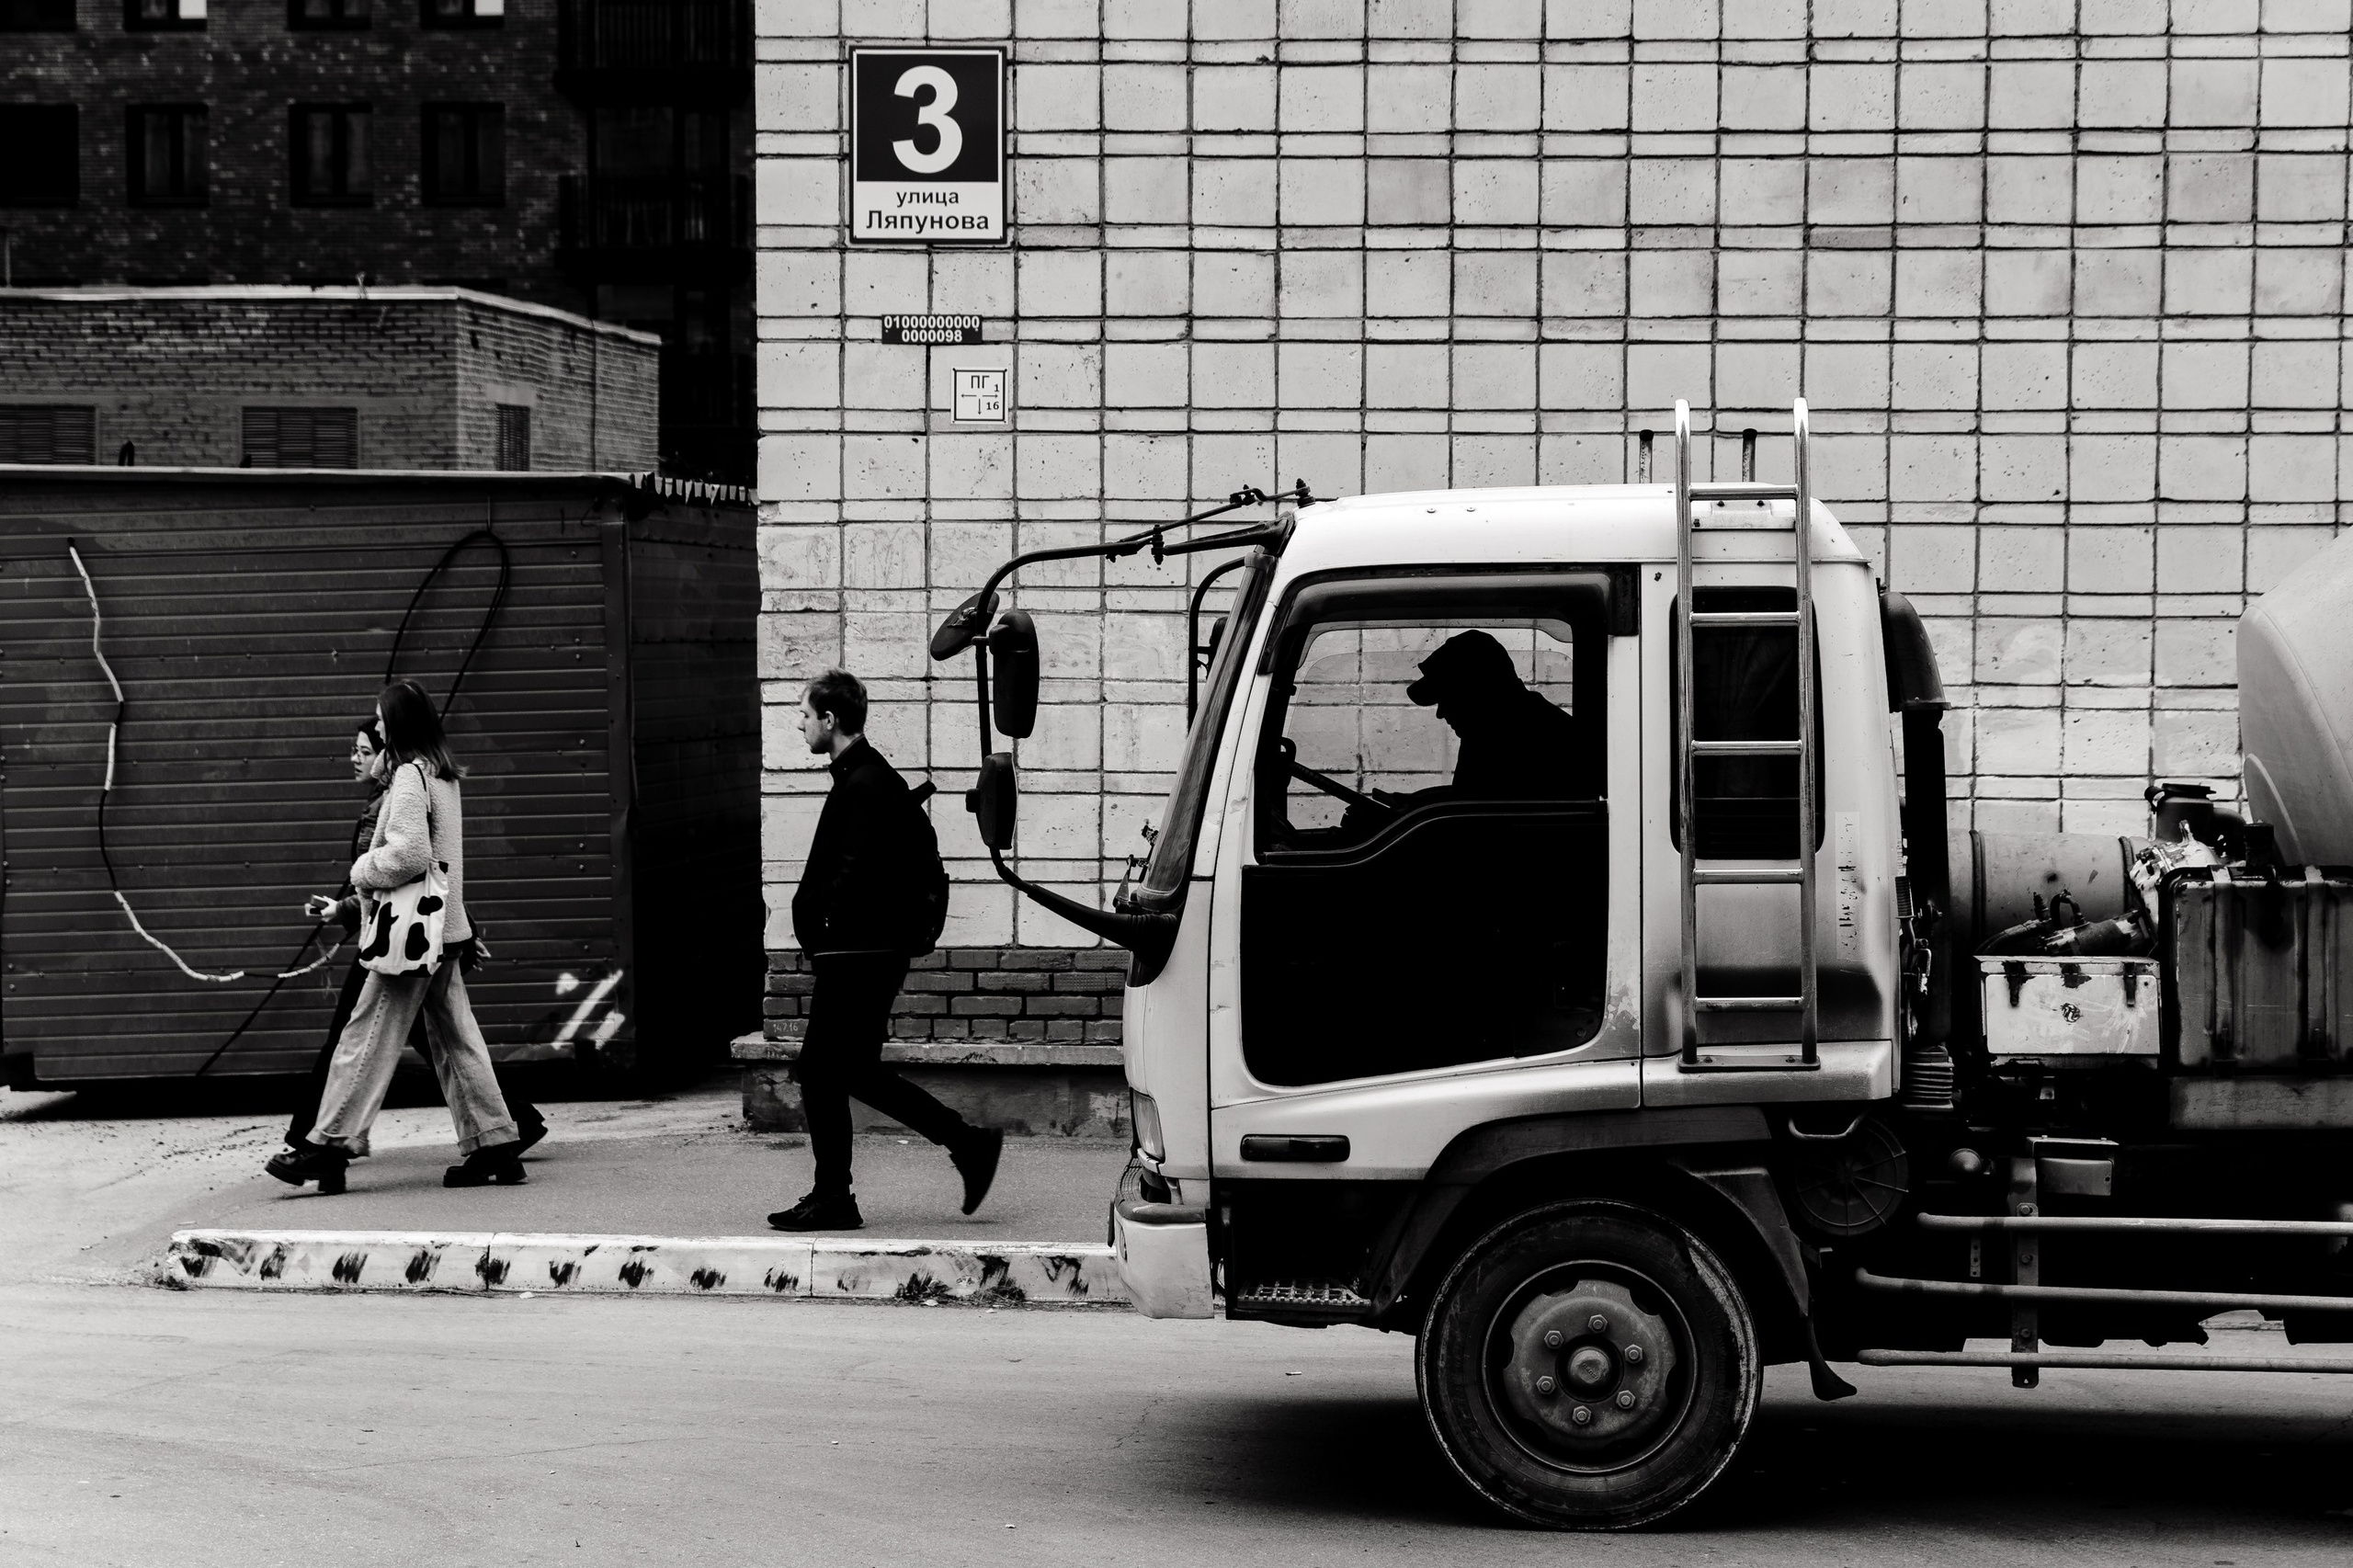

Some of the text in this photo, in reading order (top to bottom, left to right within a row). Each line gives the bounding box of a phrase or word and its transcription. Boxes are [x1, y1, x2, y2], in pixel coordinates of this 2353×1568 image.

[892, 65, 963, 174] 3
[896, 191, 960, 208] улица
[866, 210, 989, 235] Ляпунова
[883, 315, 981, 329] 01000000000
[901, 329, 963, 343] 0000098
[971, 375, 990, 389] ПГ
[994, 383, 1000, 392] 1
[986, 401, 1000, 411] 16
